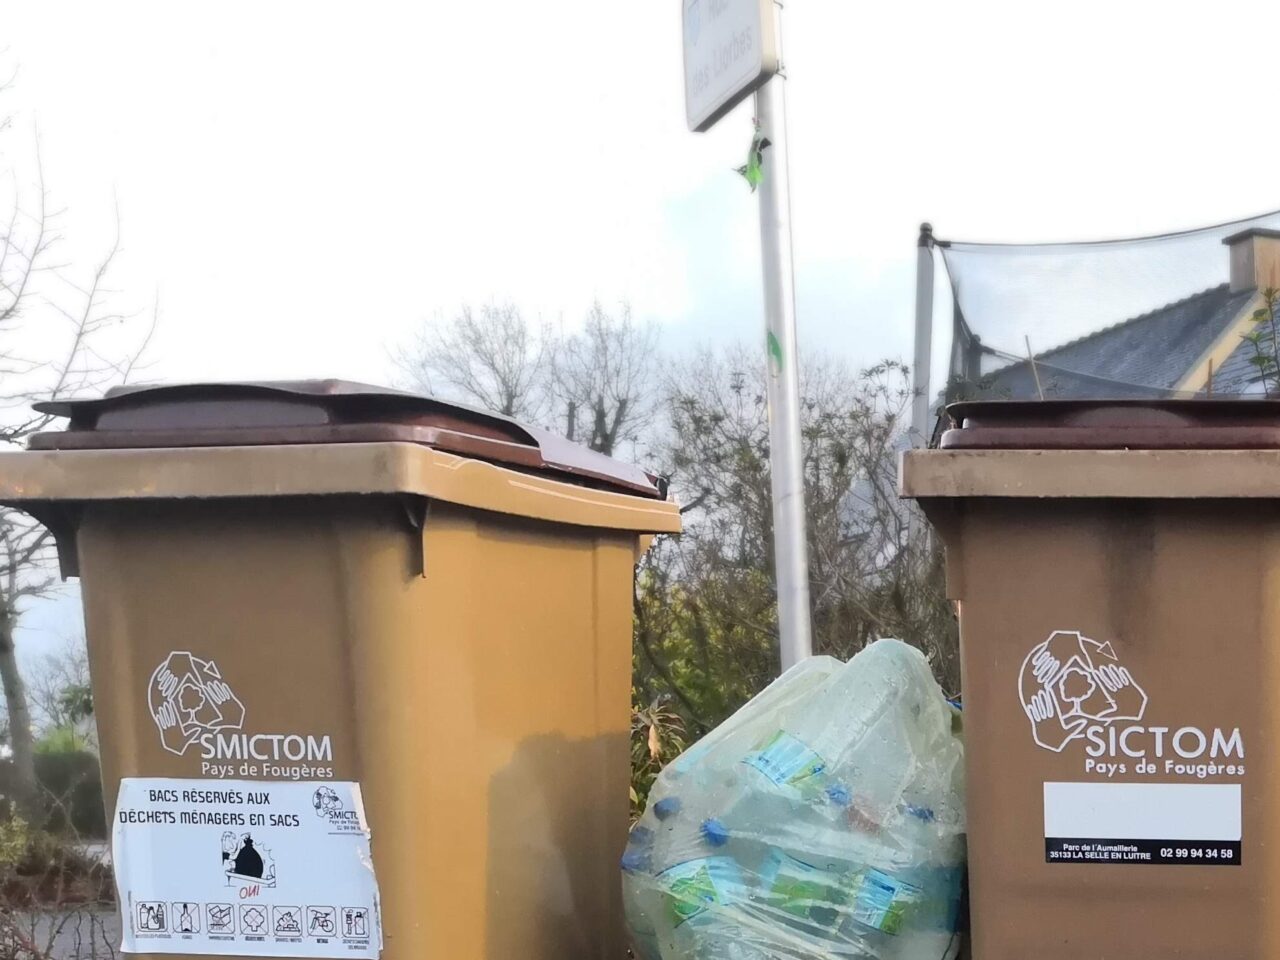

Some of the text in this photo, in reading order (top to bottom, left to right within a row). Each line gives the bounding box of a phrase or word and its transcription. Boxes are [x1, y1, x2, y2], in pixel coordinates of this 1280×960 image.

[200, 733, 333, 761] SMICTOM
[1085, 726, 1245, 758] SICTOM
[202, 762, 333, 780] Pays de Fougères
[1085, 758, 1245, 779] Pays de Fougères
[149, 789, 178, 803] BACS
[247, 792, 270, 805] AUX
[119, 808, 176, 824] DÉCHETS
[269, 814, 299, 827] SACS
[1050, 851, 1151, 860] 35133 LA SELLE EN LUITRE
[1063, 843, 1080, 851] Parc
[1081, 843, 1090, 851] de
[1160, 848, 1233, 859] 02 99 94 34 58
[239, 885, 260, 898] OUI
